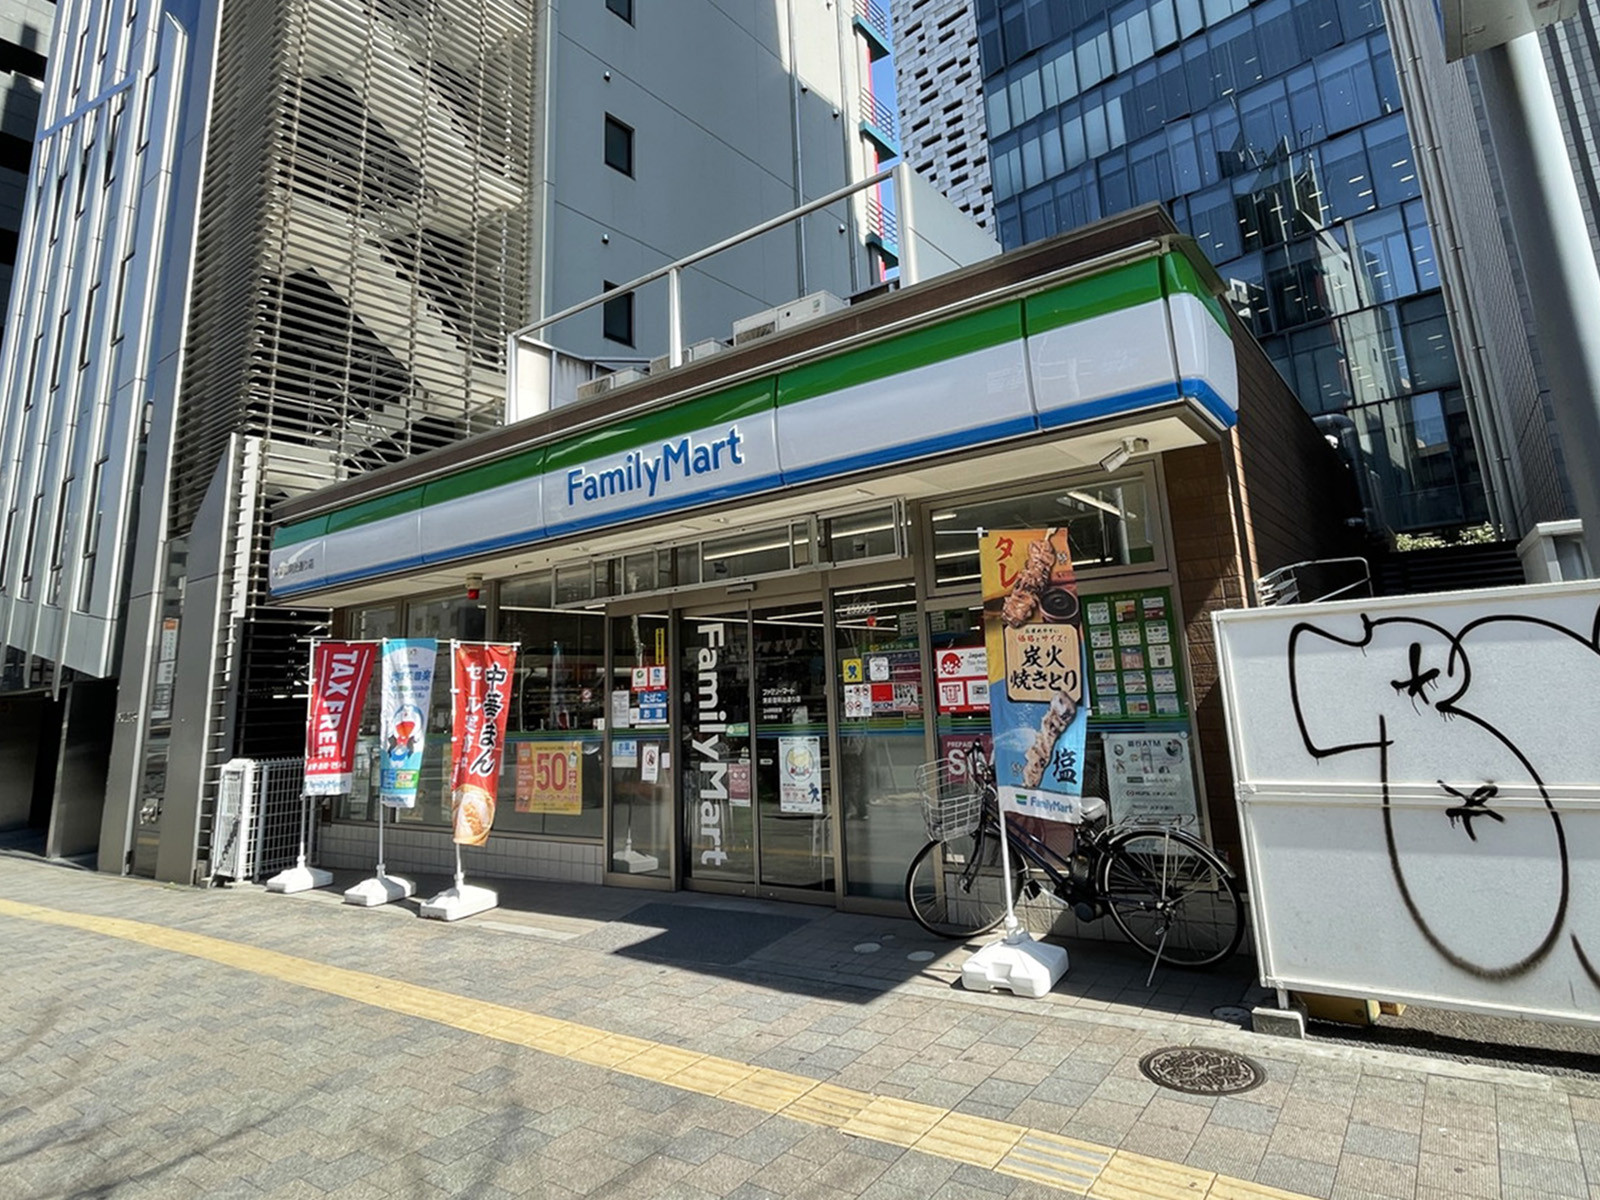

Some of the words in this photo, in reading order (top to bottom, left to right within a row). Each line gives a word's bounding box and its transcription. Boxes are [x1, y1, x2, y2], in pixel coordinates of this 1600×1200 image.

[567, 425, 744, 506] FamilyMart
[996, 537, 1019, 589] タレ
[325, 650, 359, 697] TAX
[1010, 669, 1077, 692] 焼きとり
[1021, 645, 1066, 669] 炭火
[318, 701, 346, 759] FREE
[470, 663, 507, 777] 中華まん
[692, 622, 728, 866] FamilyMart
[1053, 748, 1078, 785] 塩
[536, 752, 567, 791] 50
[1030, 796, 1074, 813] FamilyMart
